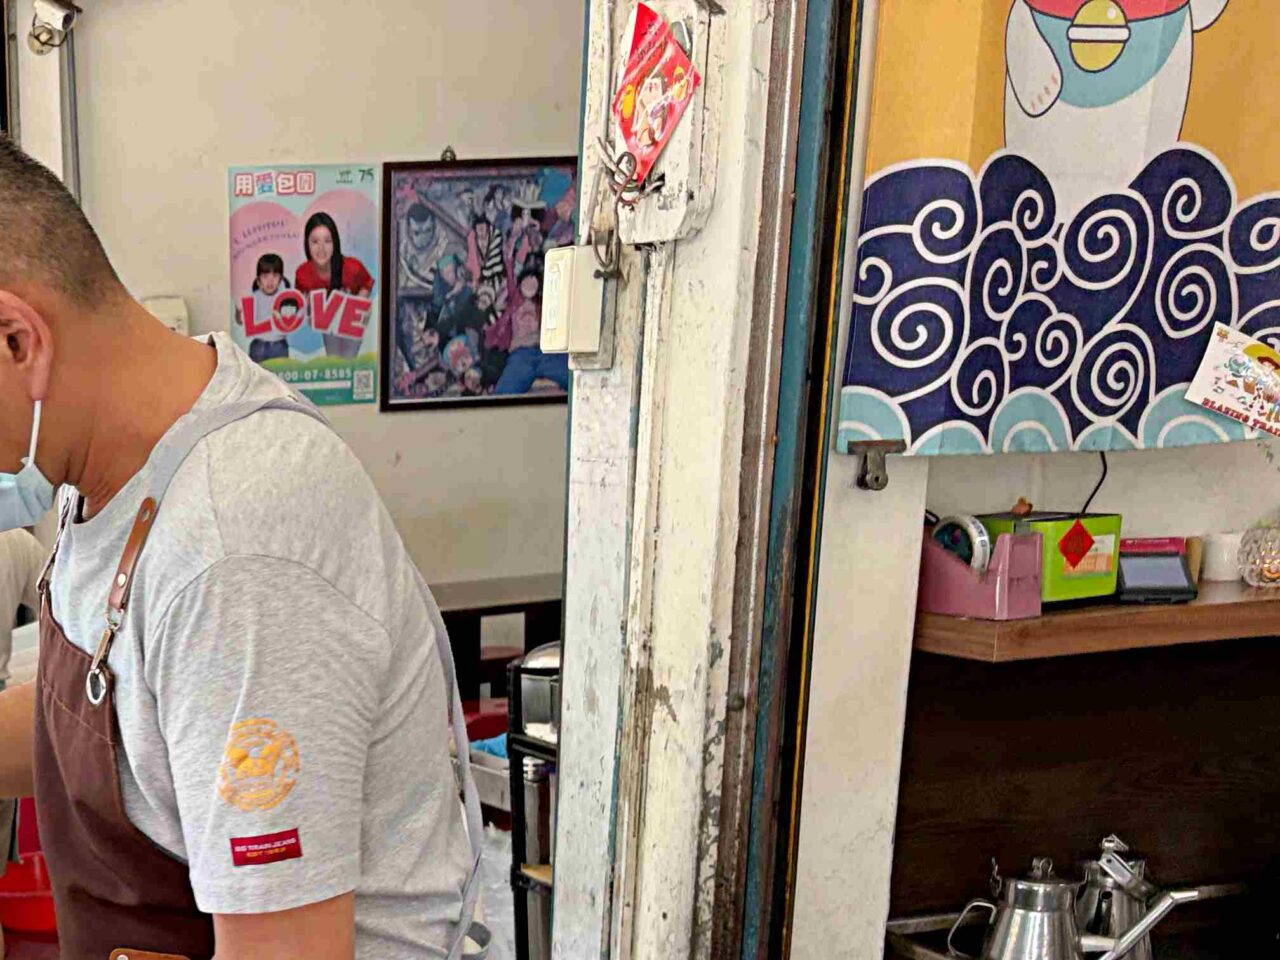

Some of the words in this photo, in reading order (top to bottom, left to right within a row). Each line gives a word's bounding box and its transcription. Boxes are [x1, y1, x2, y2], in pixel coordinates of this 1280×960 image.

[234, 171, 314, 197] 用愛包圍
[241, 289, 372, 338] LOVE
